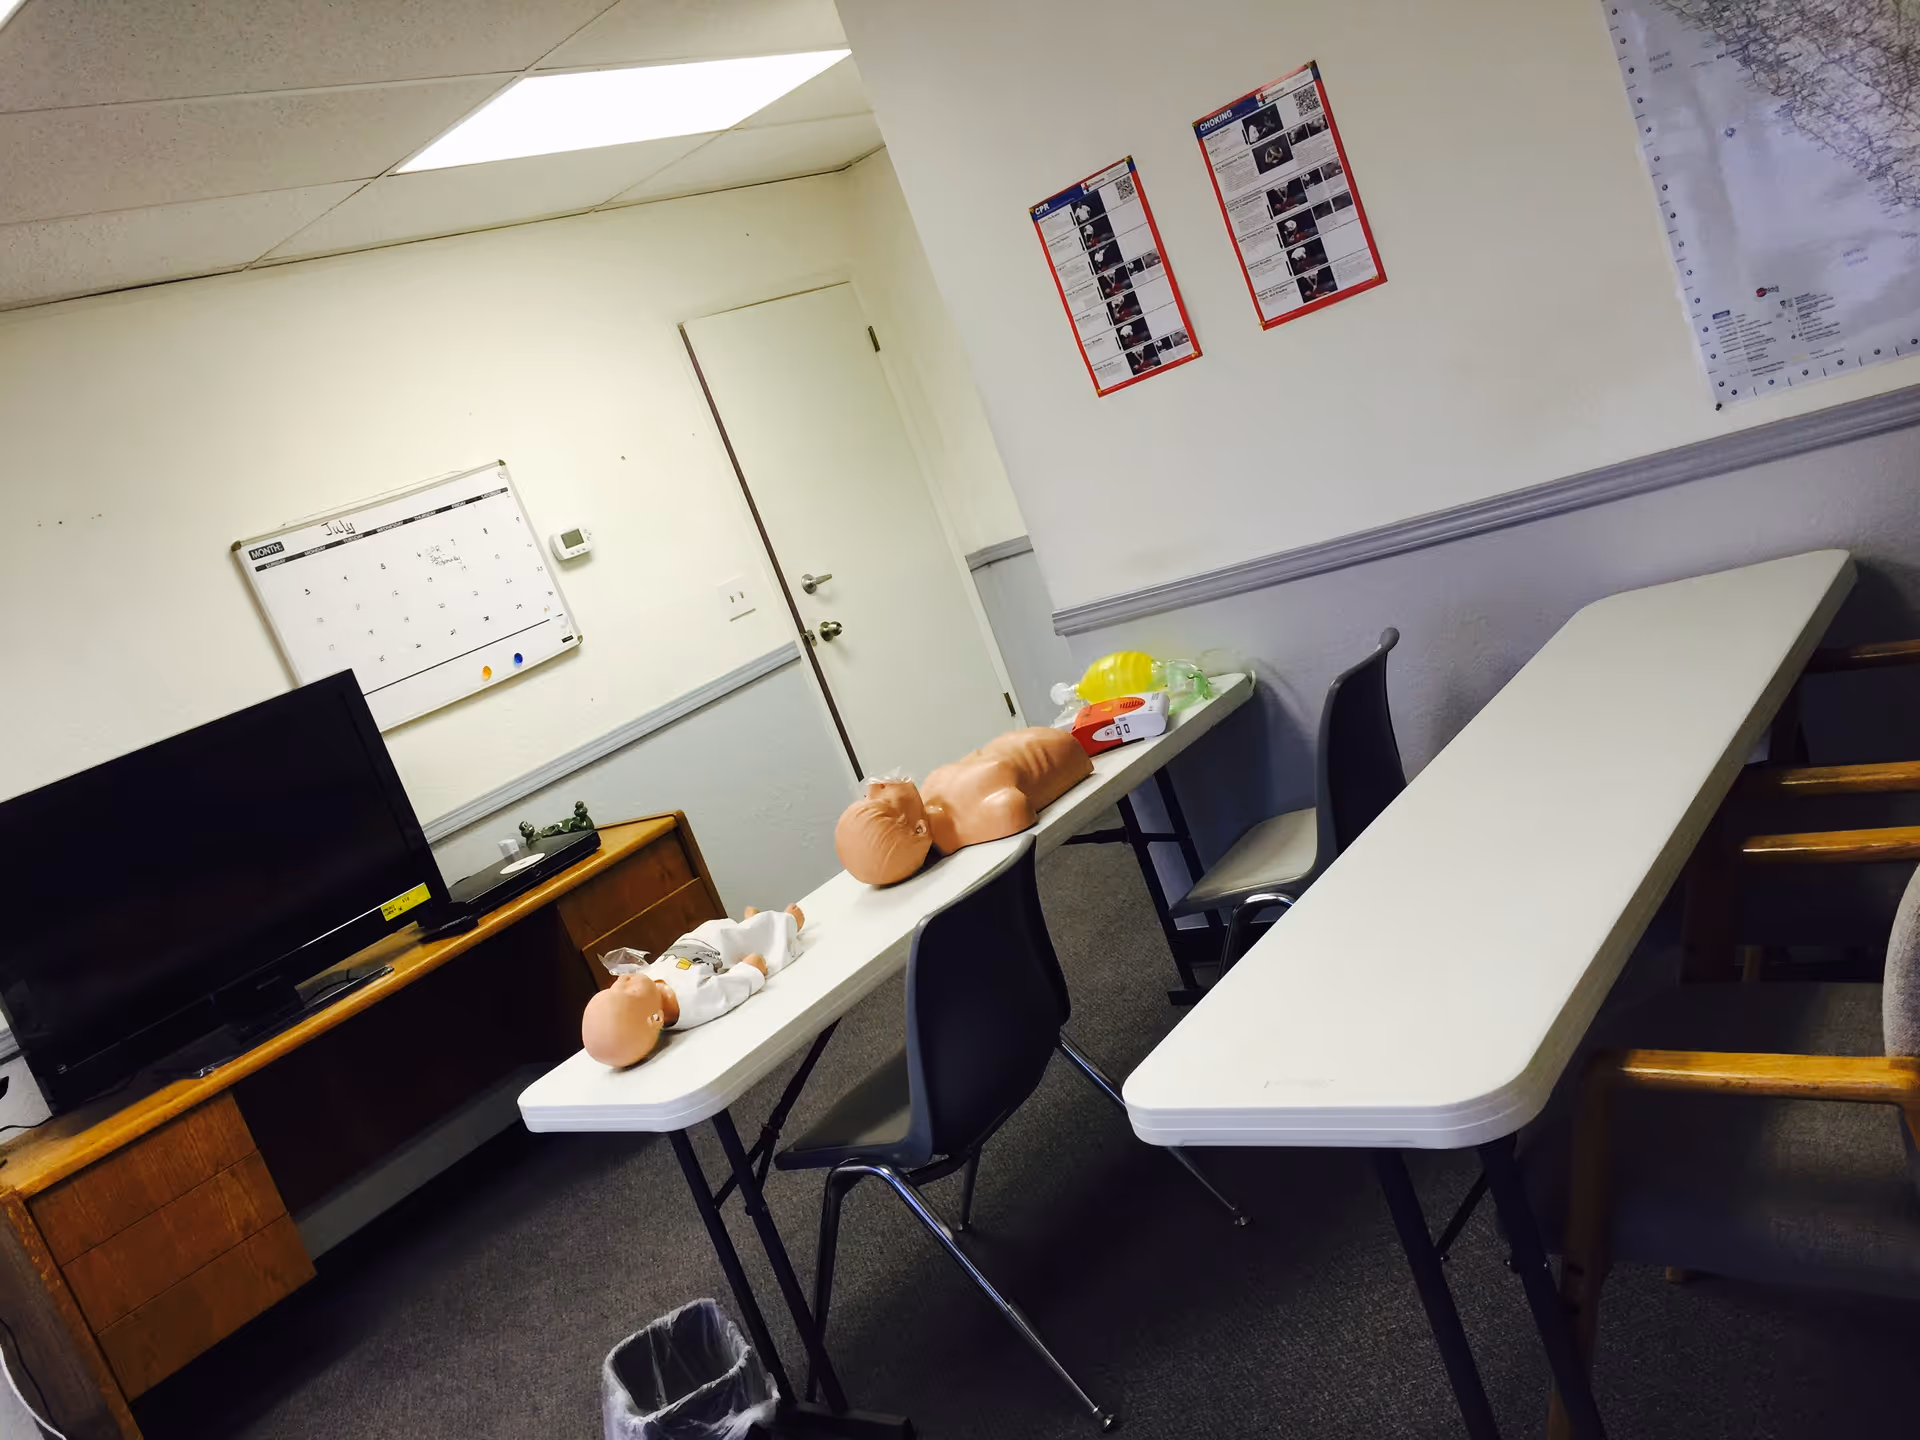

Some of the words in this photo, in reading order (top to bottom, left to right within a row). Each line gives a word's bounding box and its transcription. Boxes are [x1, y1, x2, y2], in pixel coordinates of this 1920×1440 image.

[1199, 109, 1233, 132] CHOKING
[1034, 203, 1050, 216] CPR
[321, 519, 356, 535] July
[250, 544, 282, 559] MONTH:
[304, 545, 327, 556] MONDAY
